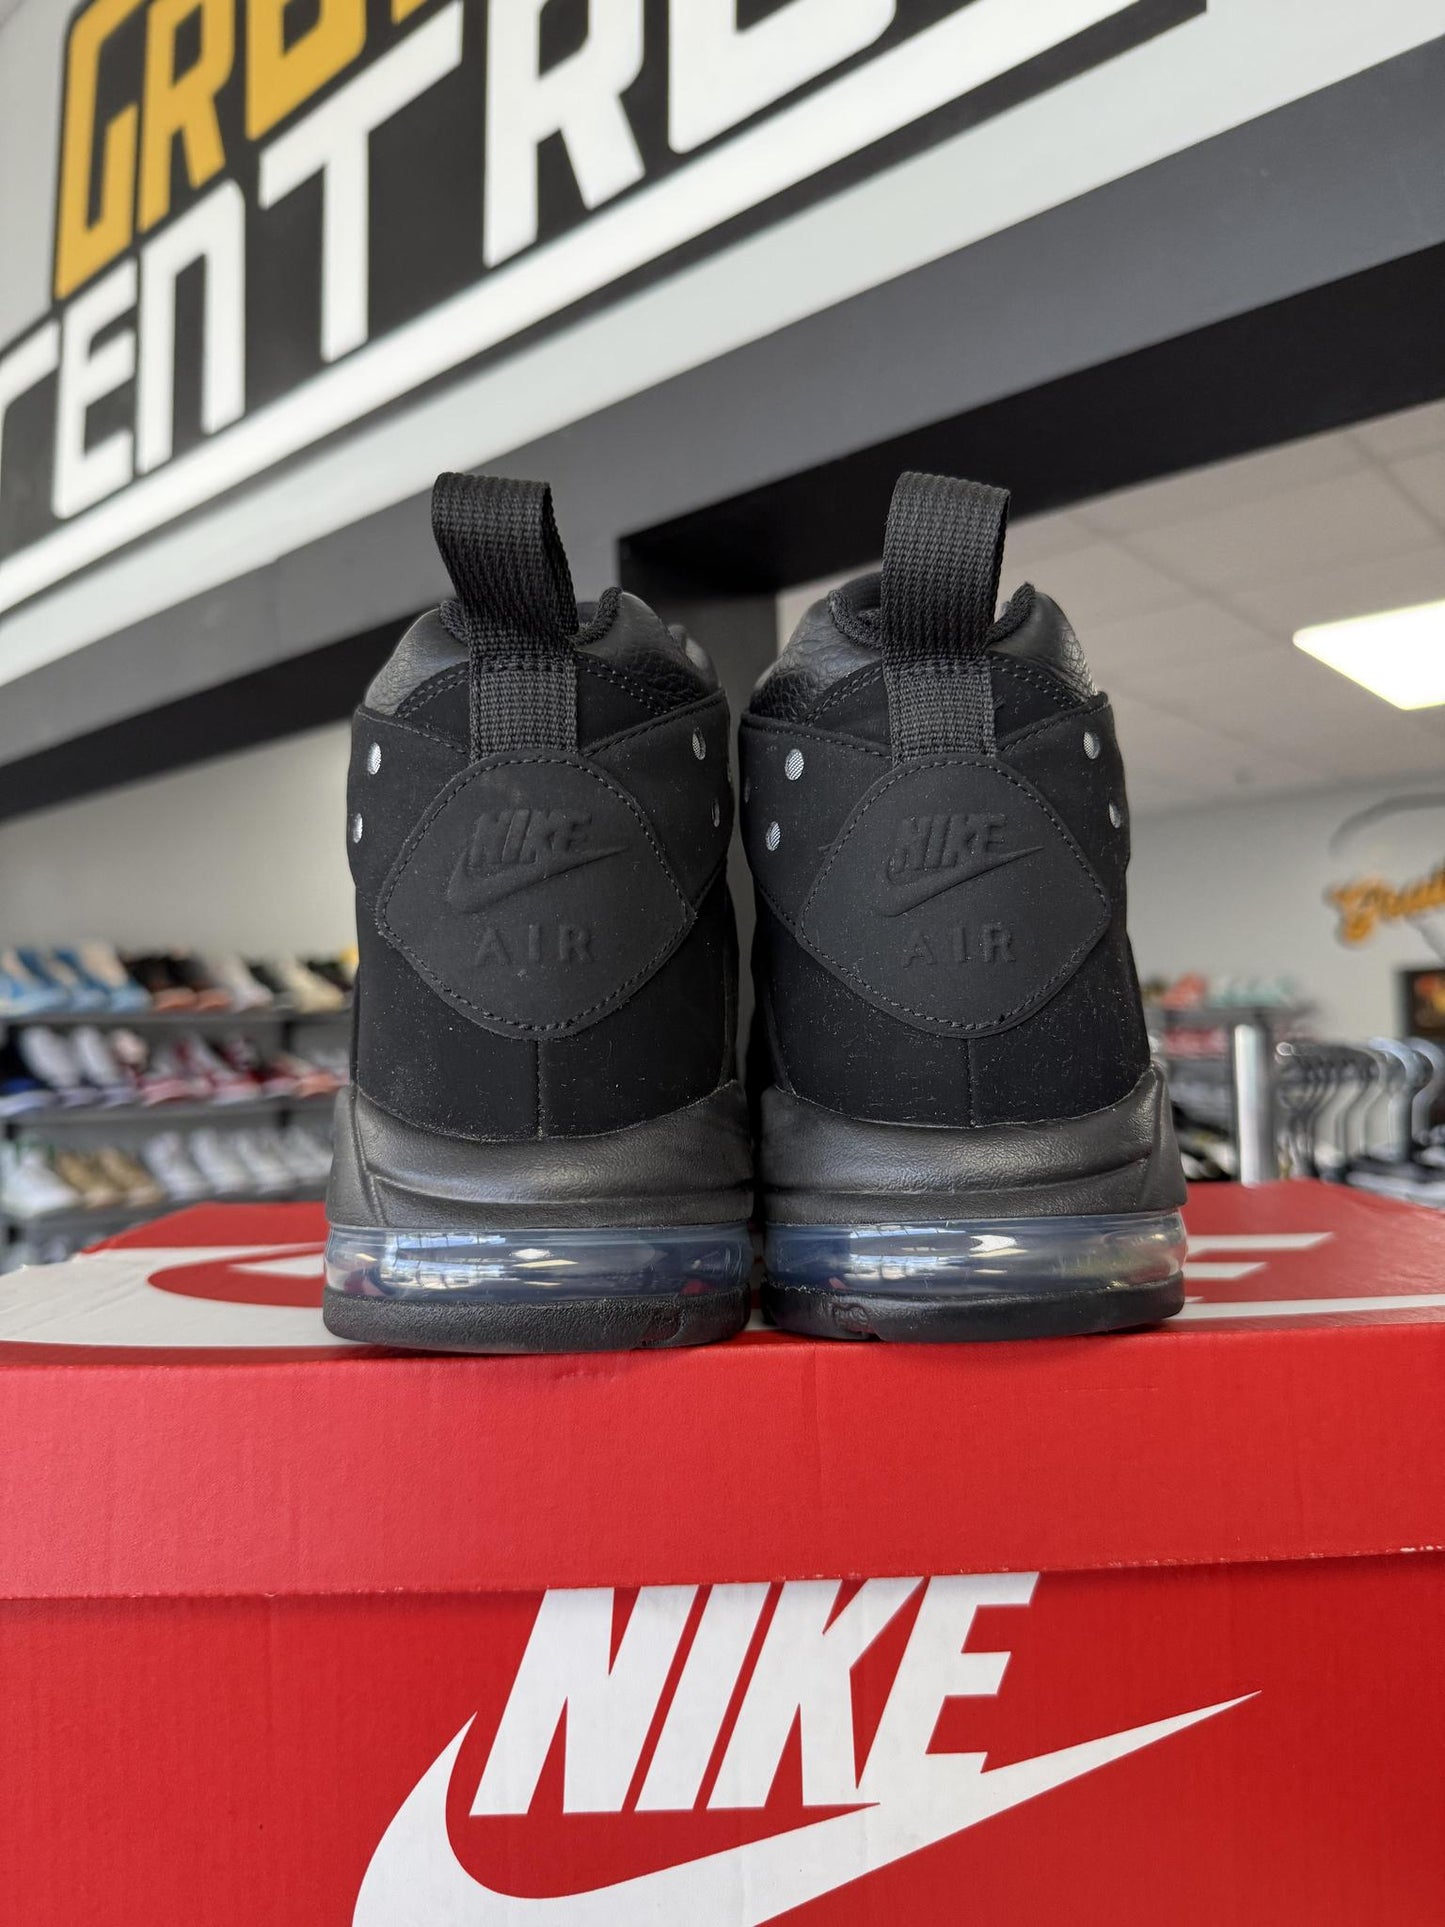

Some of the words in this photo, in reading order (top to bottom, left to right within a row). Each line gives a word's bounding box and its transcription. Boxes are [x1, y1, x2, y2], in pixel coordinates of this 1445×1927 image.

[468, 808, 594, 866] NIKE
[889, 813, 1008, 873] NIKE
[473, 923, 596, 967] AIR
[902, 922, 1017, 969] AIR
[469, 1571, 1041, 1817] NIKE
